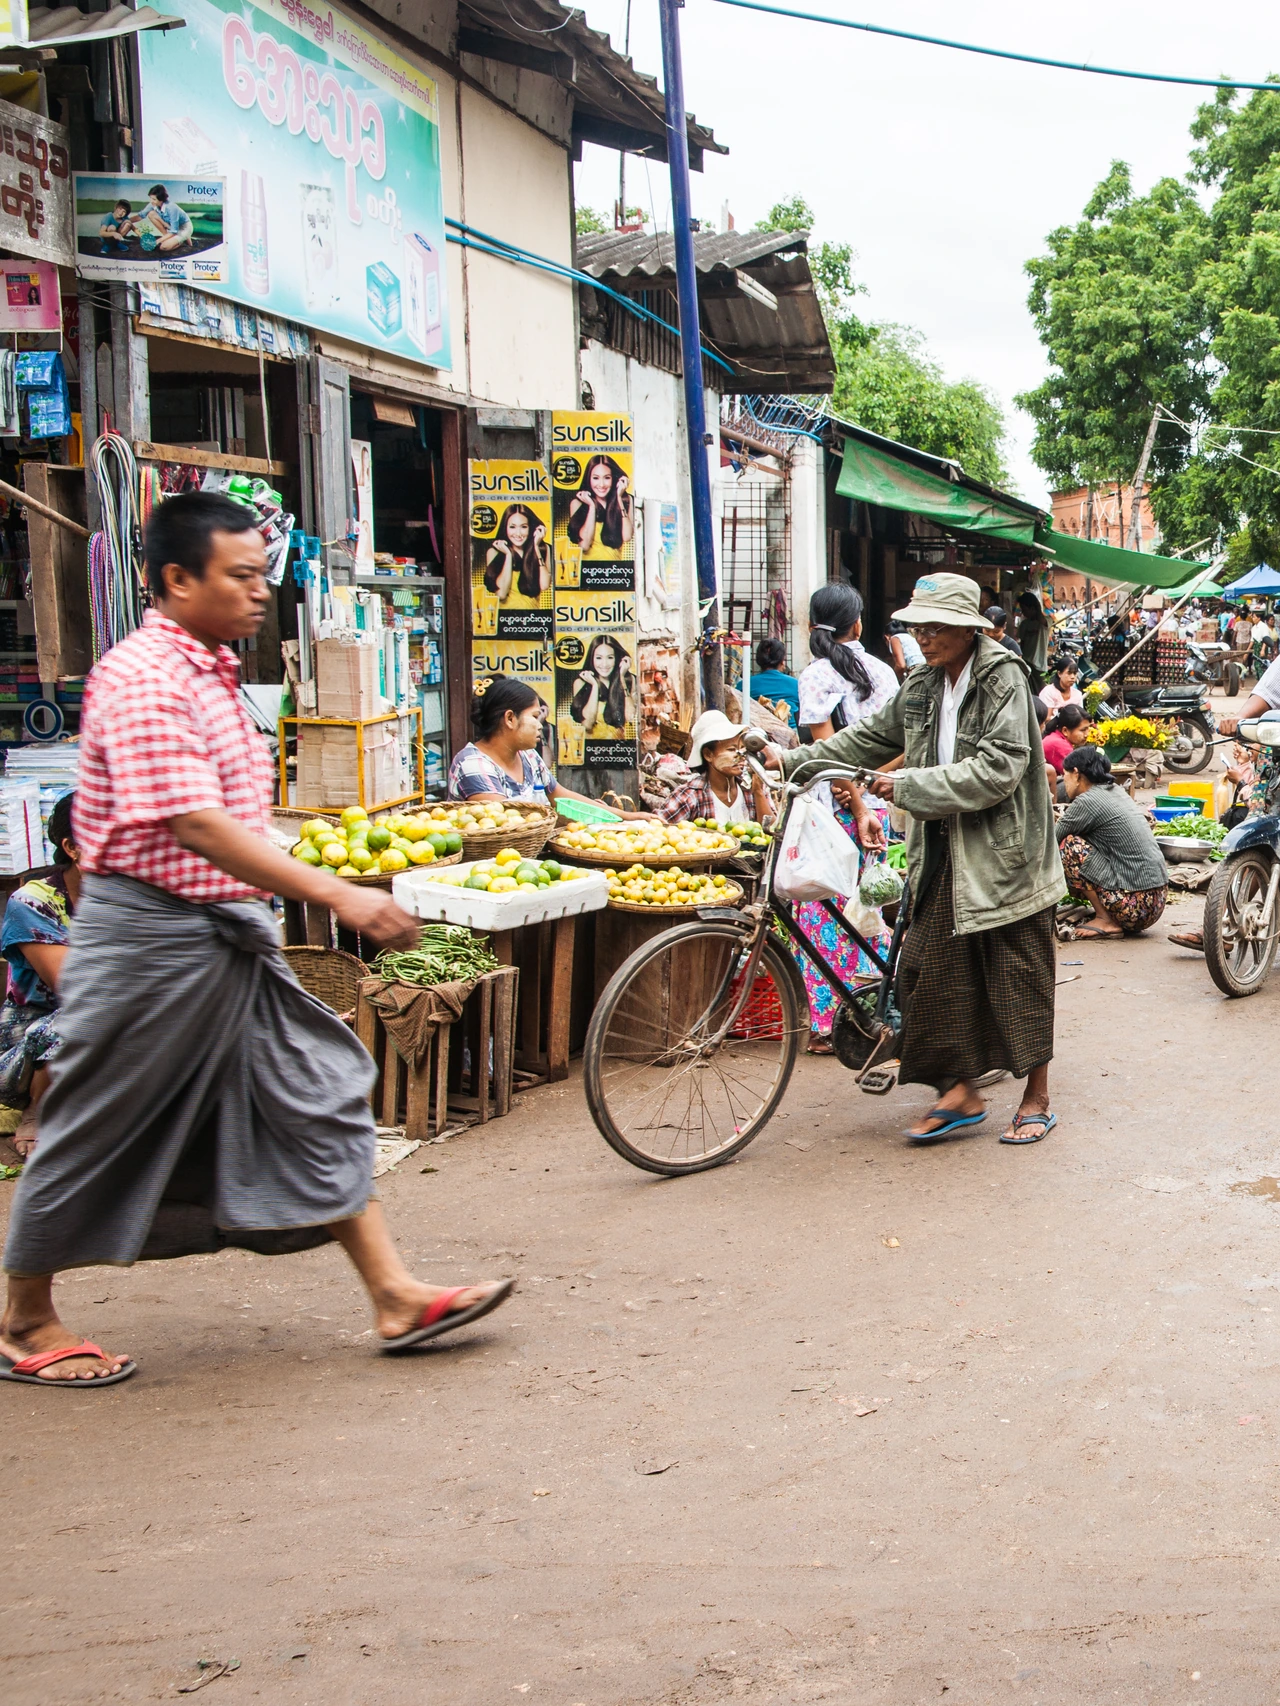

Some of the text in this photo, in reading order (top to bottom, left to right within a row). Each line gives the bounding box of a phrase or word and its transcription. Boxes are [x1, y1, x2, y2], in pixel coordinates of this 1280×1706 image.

[223, 12, 386, 226] အေးသုခ
[188, 184, 218, 196] Protex
[160, 262, 185, 271] Protex
[194, 263, 219, 272] Protex
[553, 420, 633, 442] sunsilk
[471, 469, 549, 492] sunsilk
[556, 600, 634, 623] sunsilk
[473, 650, 553, 672] sunsilk
